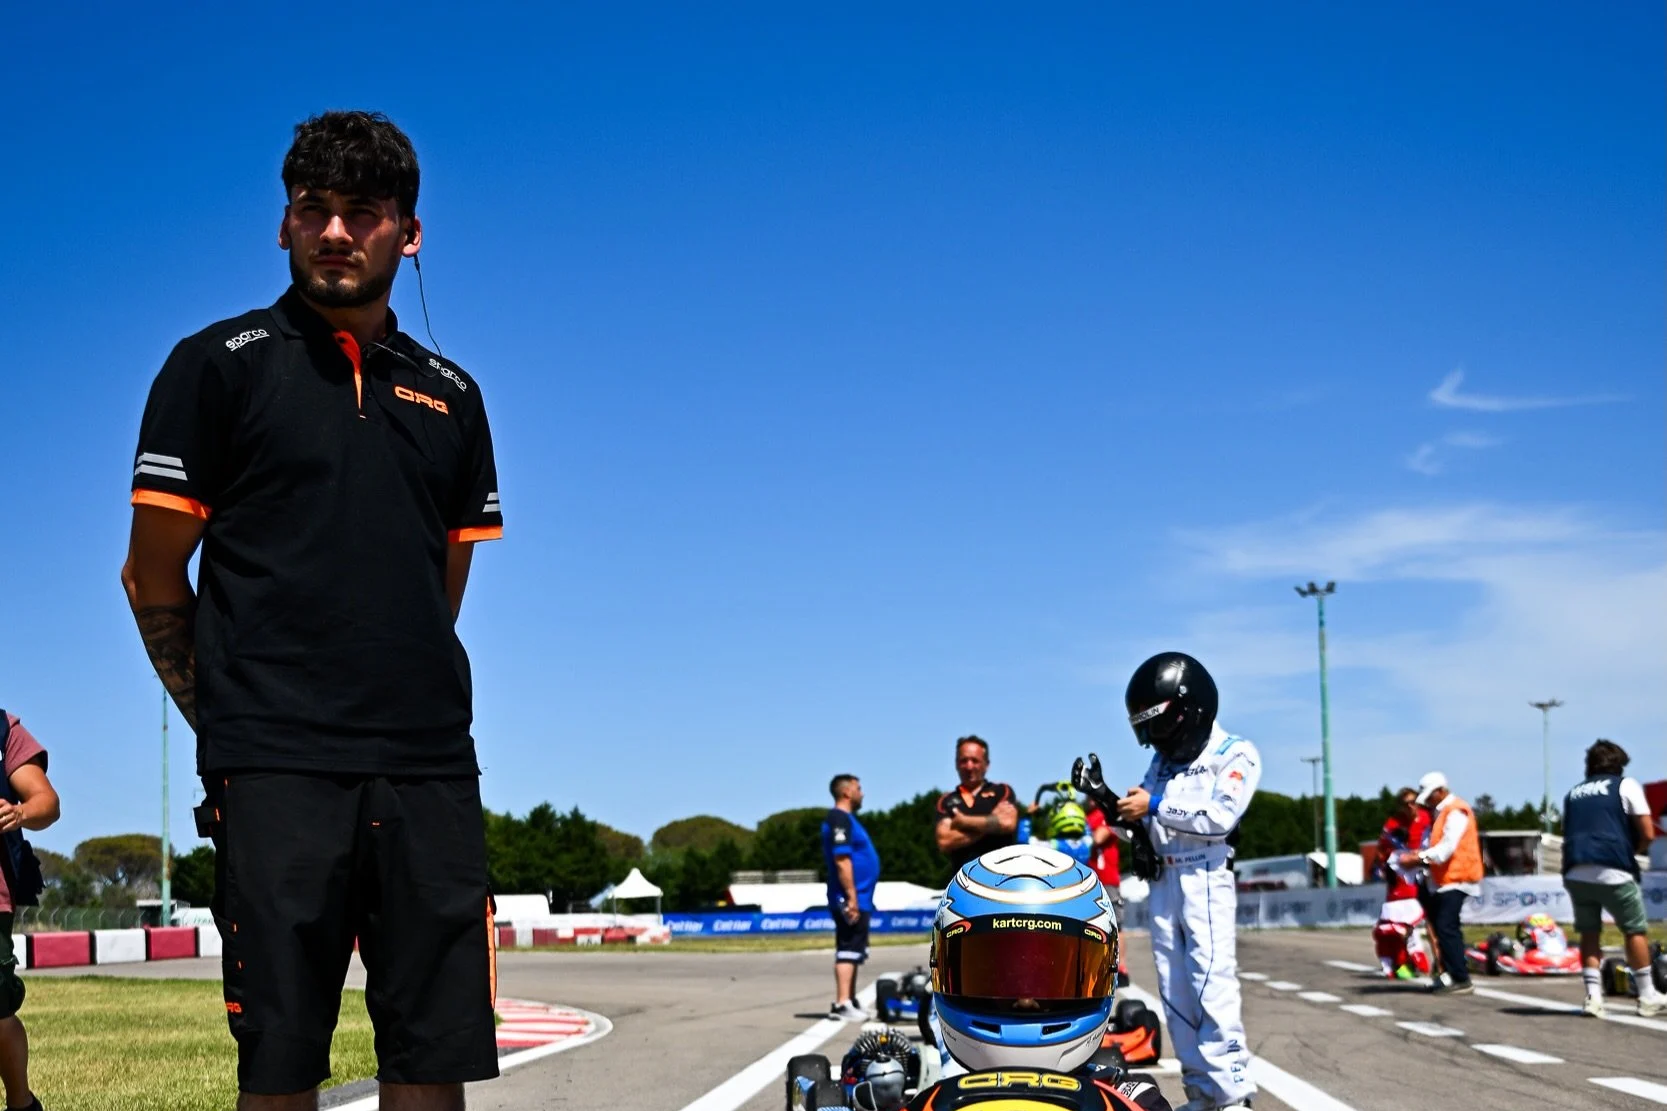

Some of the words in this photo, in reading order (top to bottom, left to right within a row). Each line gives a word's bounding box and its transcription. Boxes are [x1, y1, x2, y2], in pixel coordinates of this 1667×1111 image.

[225, 328, 270, 352] sparco
[394, 385, 449, 415] CRG
[992, 917, 1062, 931] kartcrg.com
[946, 926, 964, 939] CRG
[1084, 928, 1102, 940] CRG
[958, 1072, 1081, 1091] CRG
